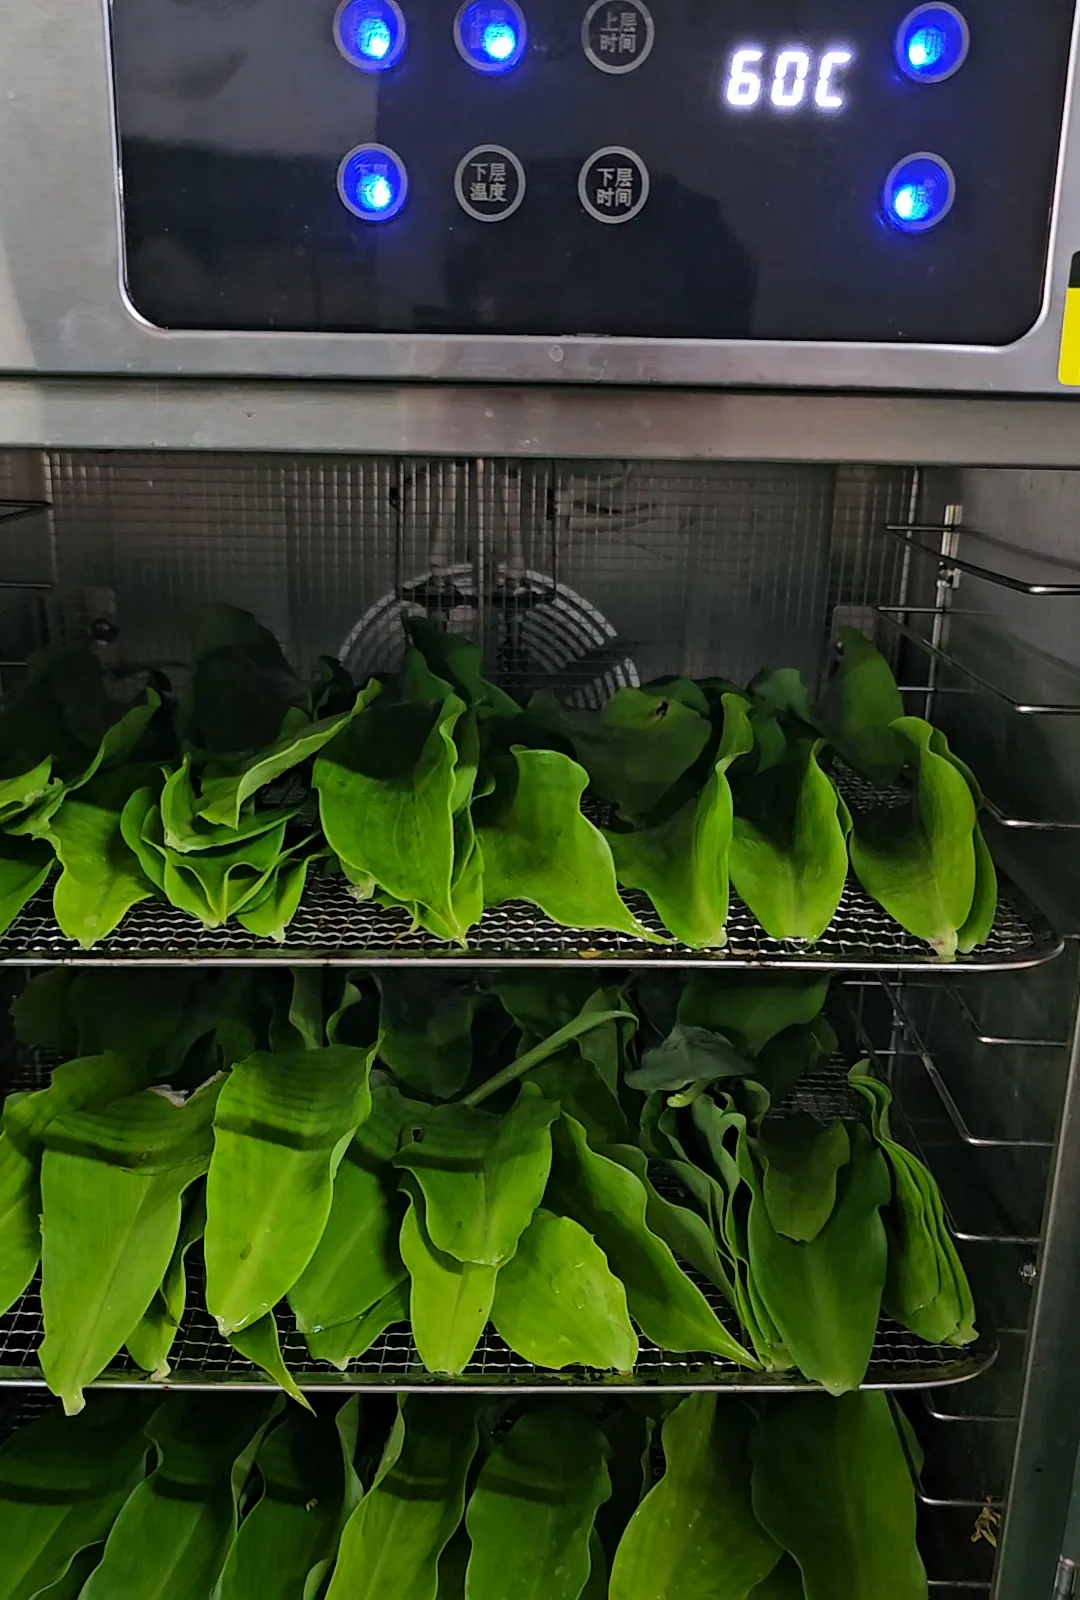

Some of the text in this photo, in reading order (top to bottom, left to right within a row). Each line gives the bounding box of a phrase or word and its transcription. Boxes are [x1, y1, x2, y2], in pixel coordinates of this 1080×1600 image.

[600, 12, 637, 33] 上层
[600, 34, 636, 54] 时间
[726, 48, 852, 108] 60C
[470, 163, 507, 182] 下层
[597, 168, 633, 187] 下层
[470, 183, 507, 202] 温度
[597, 189, 632, 208] 时间
